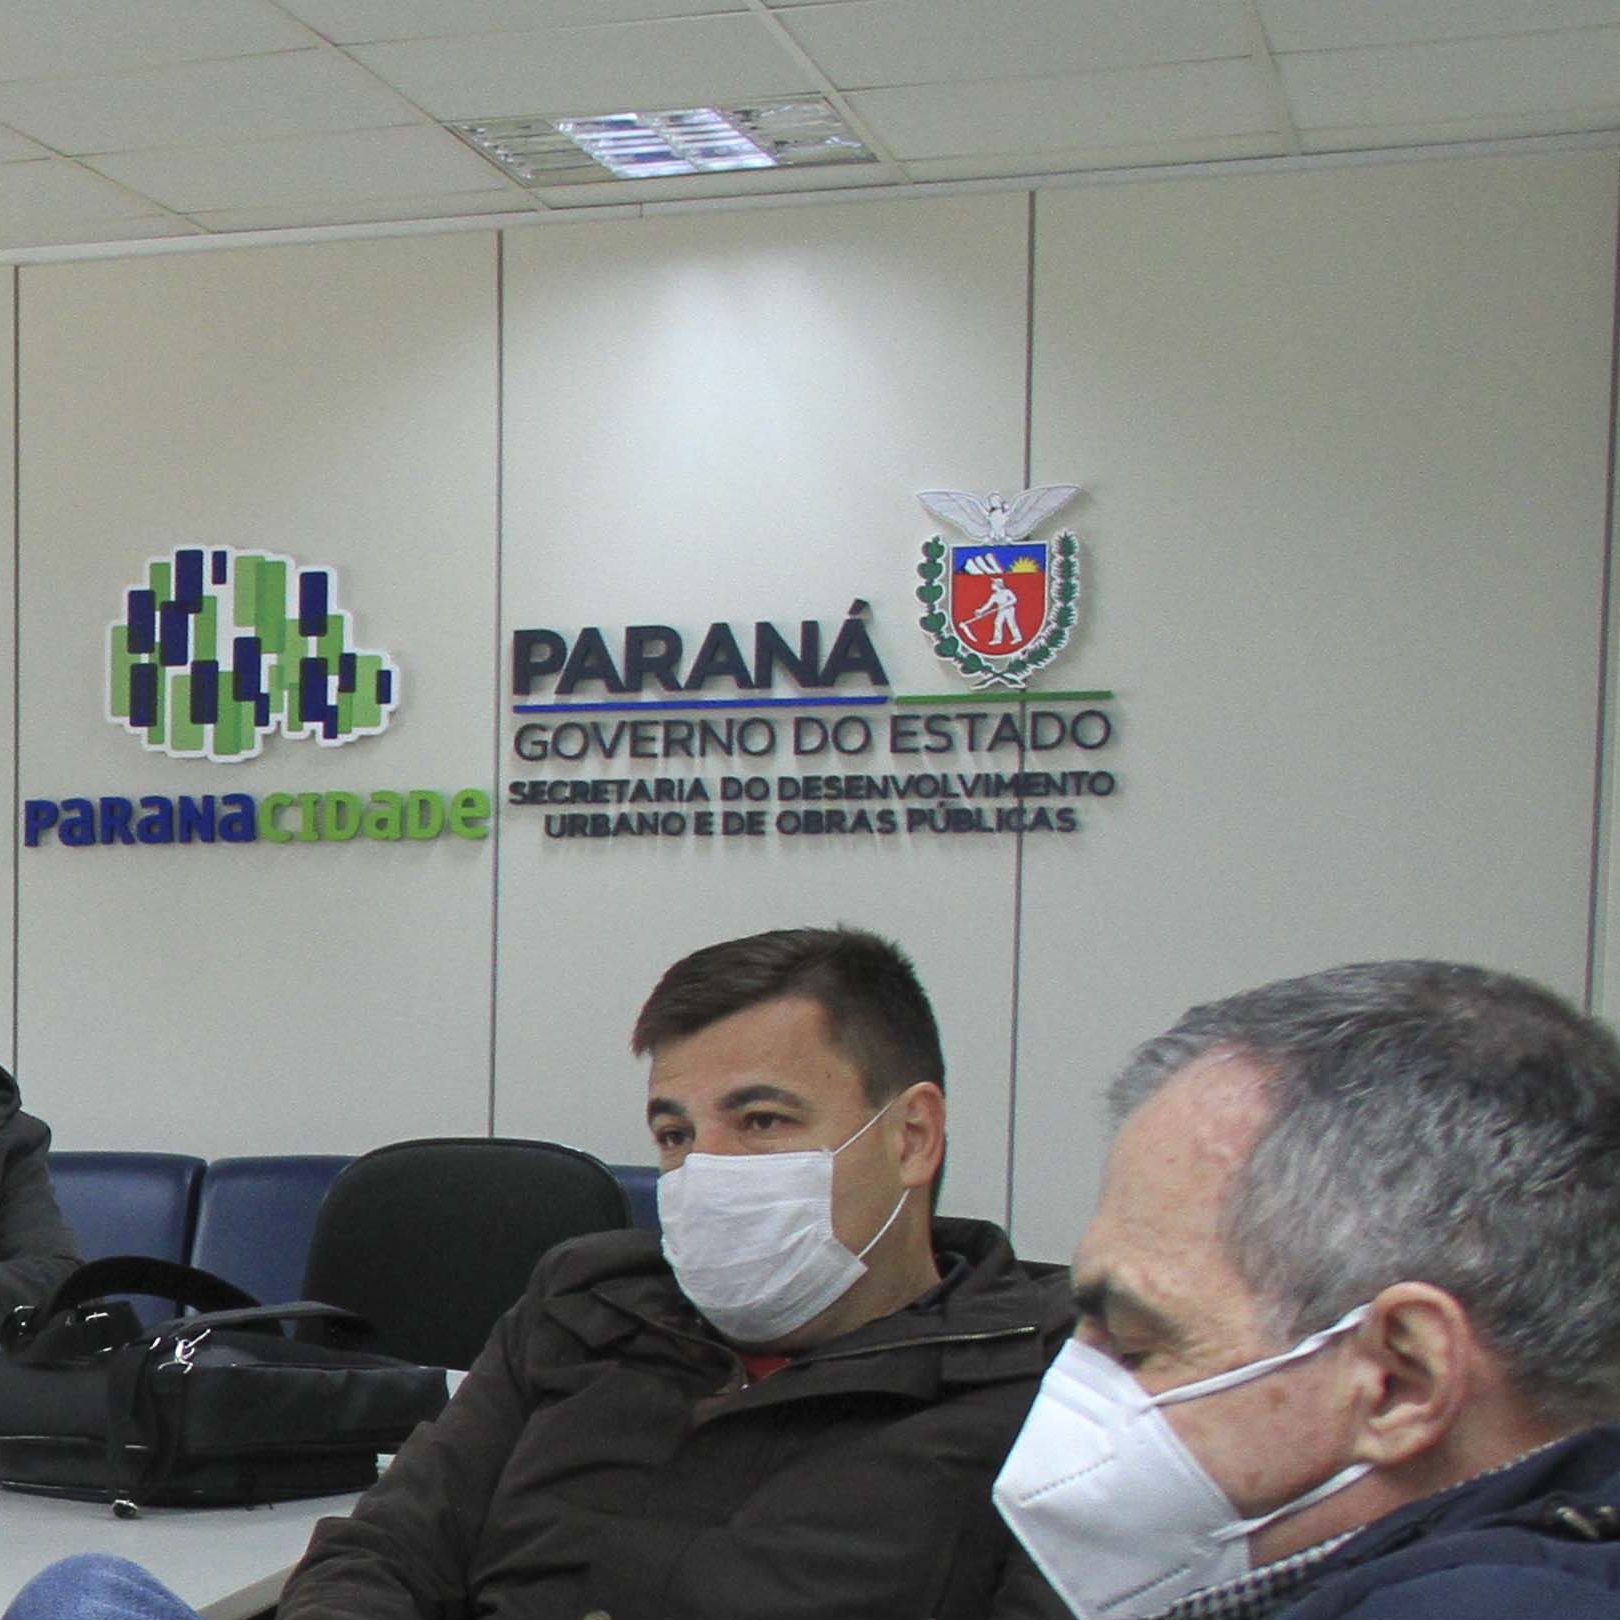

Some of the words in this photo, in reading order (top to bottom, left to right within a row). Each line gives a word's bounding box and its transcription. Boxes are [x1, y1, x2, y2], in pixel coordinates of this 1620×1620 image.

[512, 598, 890, 696] PARANÁ
[513, 717, 776, 762] GOVERNO
[793, 714, 872, 756] DO
[889, 709, 1112, 754] ESTADO
[508, 777, 710, 805] SECRETARIA
[719, 776, 771, 802] DO
[777, 770, 1116, 802] DESENVOLVIMENTO
[544, 811, 687, 838] URBANO
[694, 810, 714, 836] E
[721, 810, 766, 836] DE
[775, 807, 898, 835] OBRAS
[906, 801, 1078, 834] PÚBLICAS
